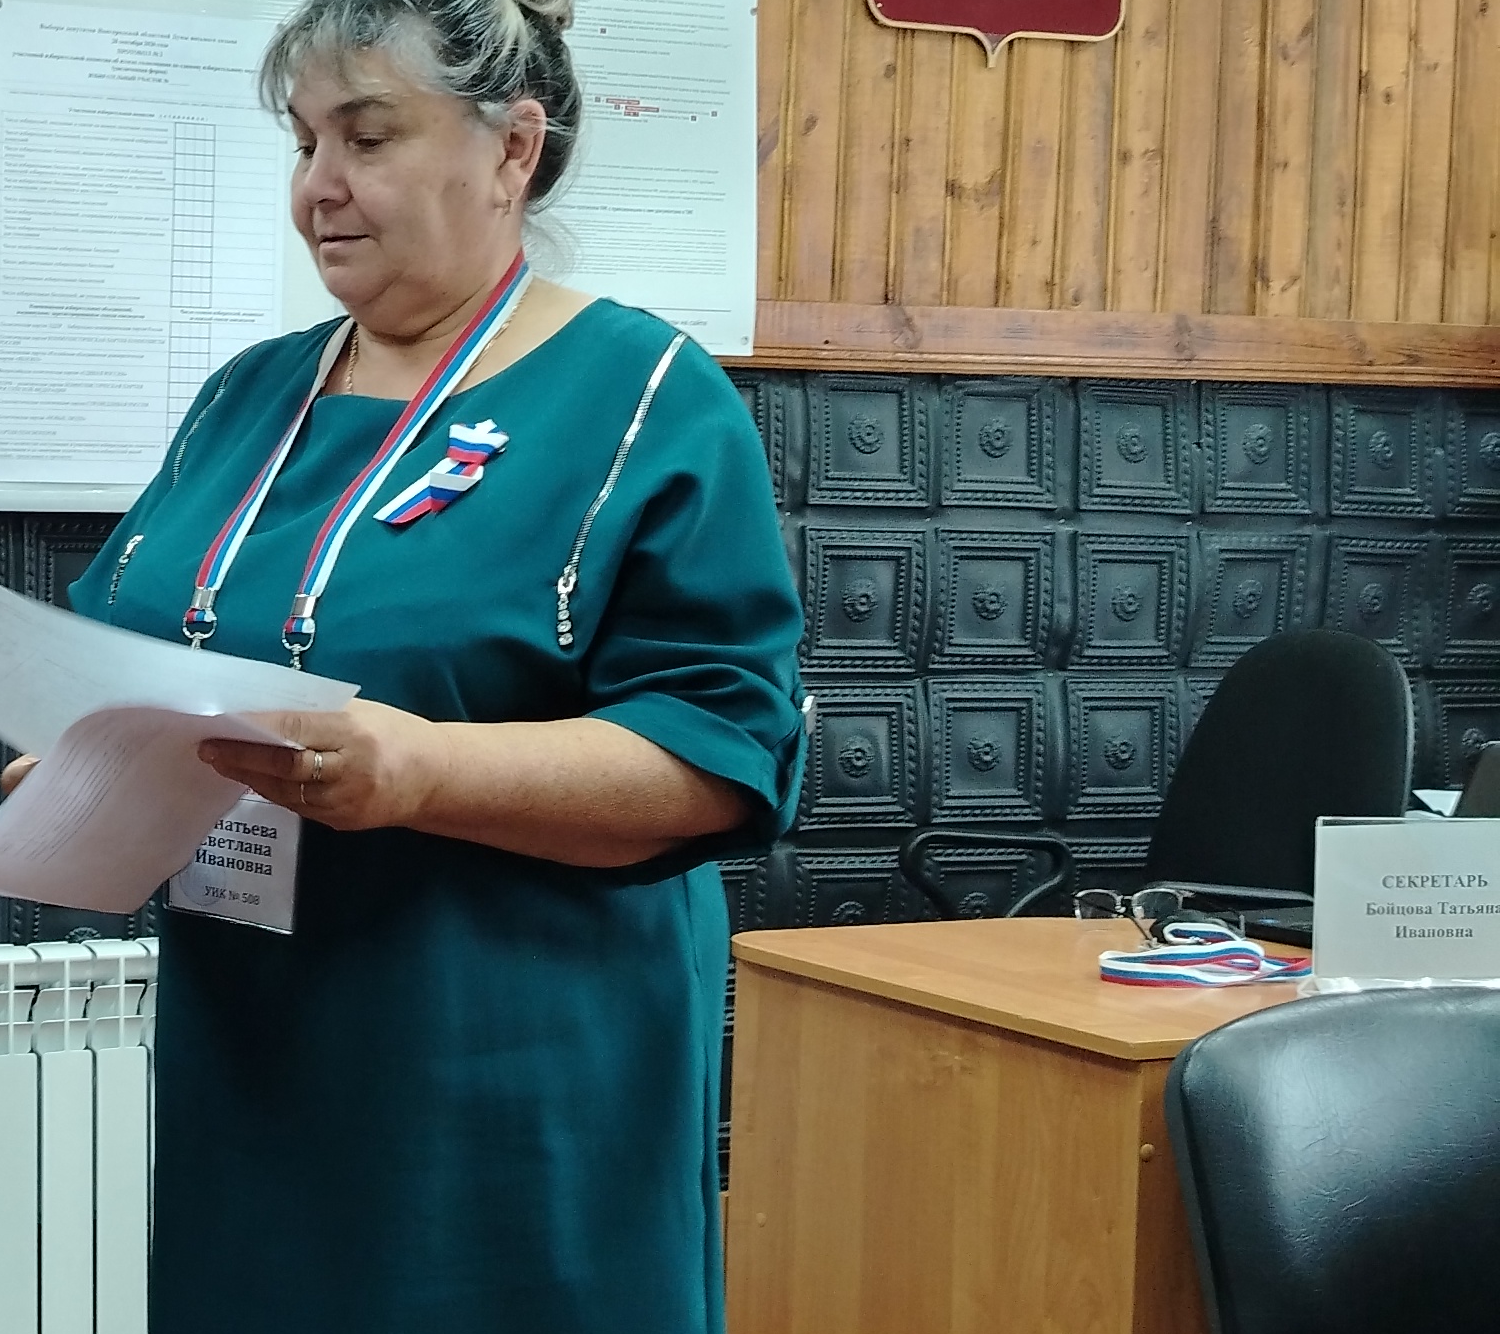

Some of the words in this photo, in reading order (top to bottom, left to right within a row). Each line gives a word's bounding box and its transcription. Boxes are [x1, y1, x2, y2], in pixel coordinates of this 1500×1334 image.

[214, 819, 277, 840] натьева
[195, 848, 273, 876] Ивановна
[1381, 873, 1489, 889] СЕКРЕТАРЬ
[204, 885, 227, 901] УИК
[1365, 901, 1433, 917] Бойцова
[1395, 925, 1474, 939] Ивановна
